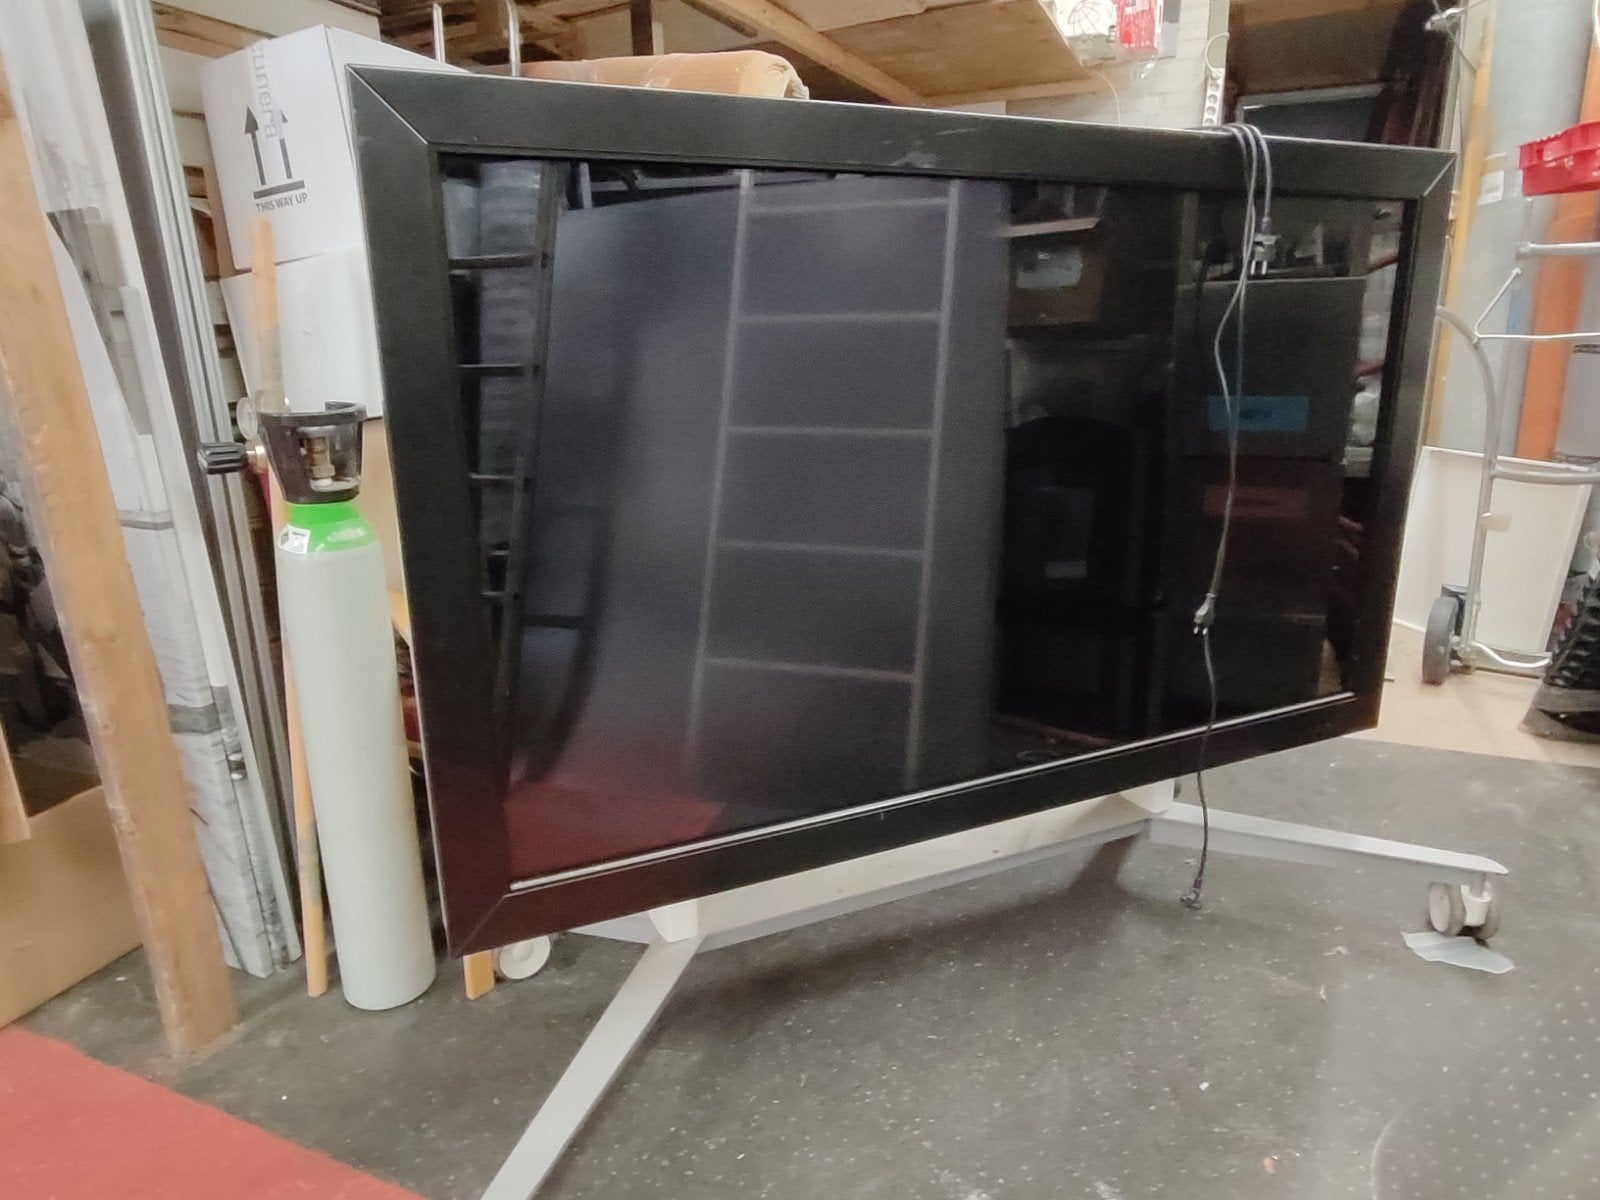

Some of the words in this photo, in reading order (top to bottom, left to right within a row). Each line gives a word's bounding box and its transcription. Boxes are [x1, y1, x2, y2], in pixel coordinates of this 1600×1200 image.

[255, 200, 275, 212] THIS
[275, 195, 294, 208] WAY
[295, 192, 308, 204] UP
